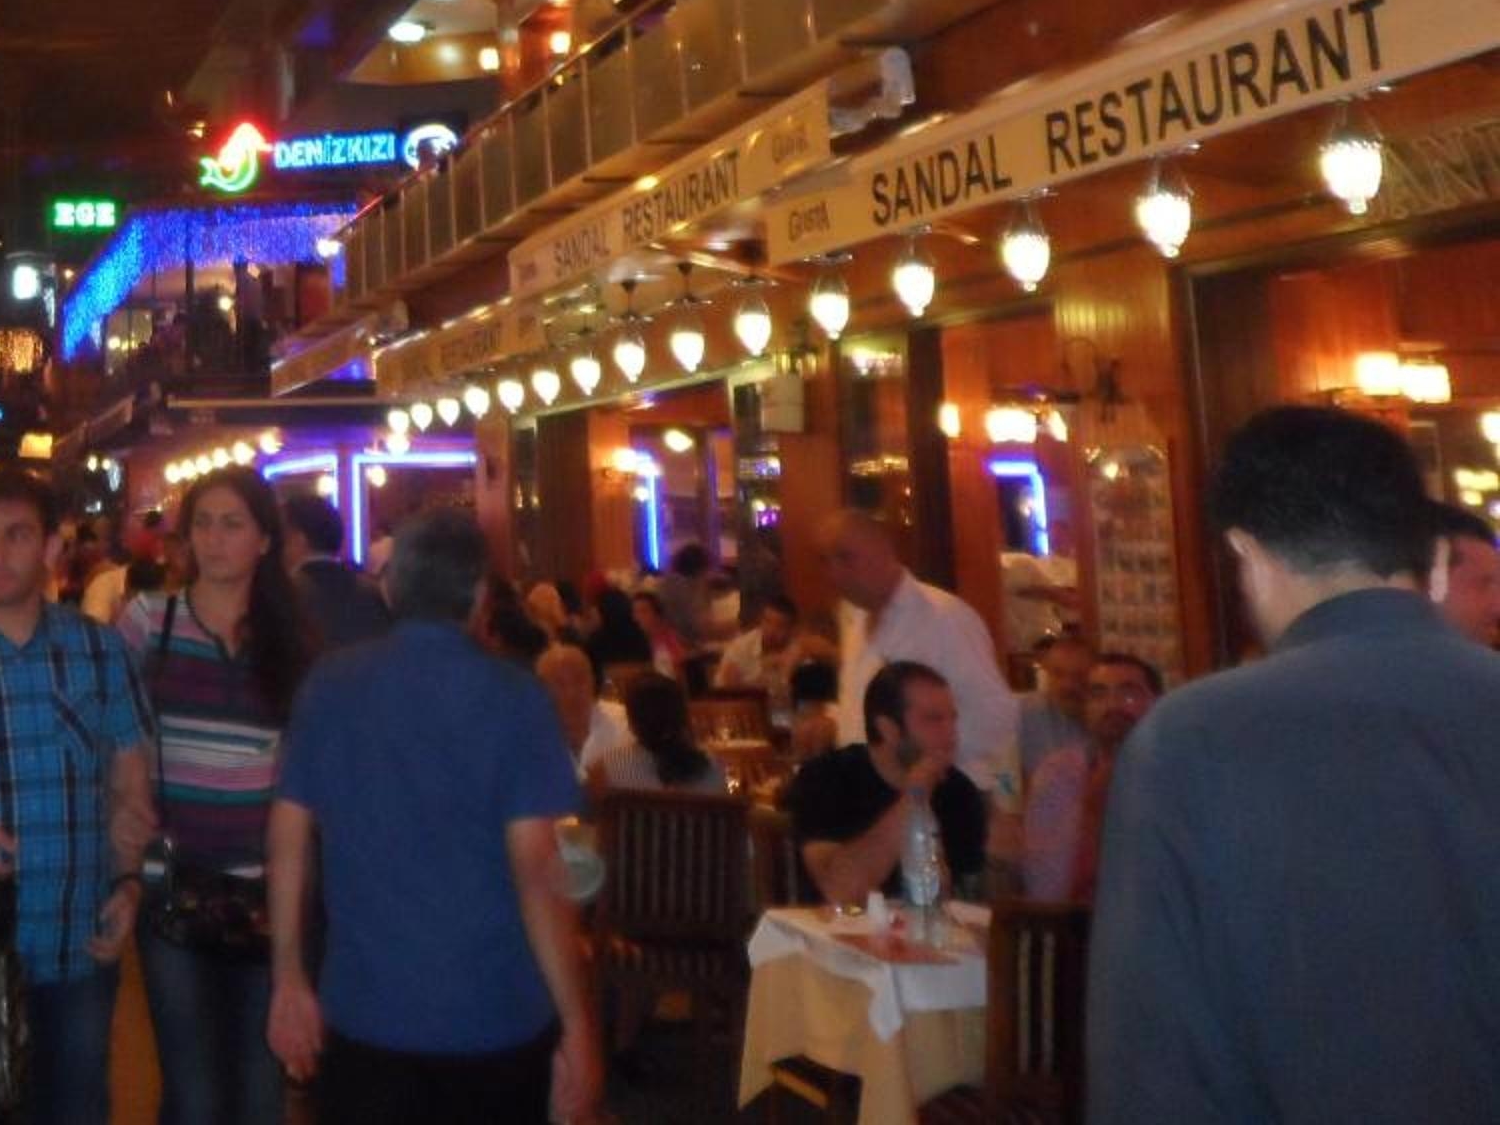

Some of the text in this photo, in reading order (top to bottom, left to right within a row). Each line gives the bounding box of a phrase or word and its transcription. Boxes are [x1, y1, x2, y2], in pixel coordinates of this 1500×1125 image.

[274, 133, 396, 169] DENİZKIZI
[872, 135, 1012, 226] SANDAL
[54, 202, 115, 227] EGE
[553, 149, 740, 278] SANDAL RESTAURANT
